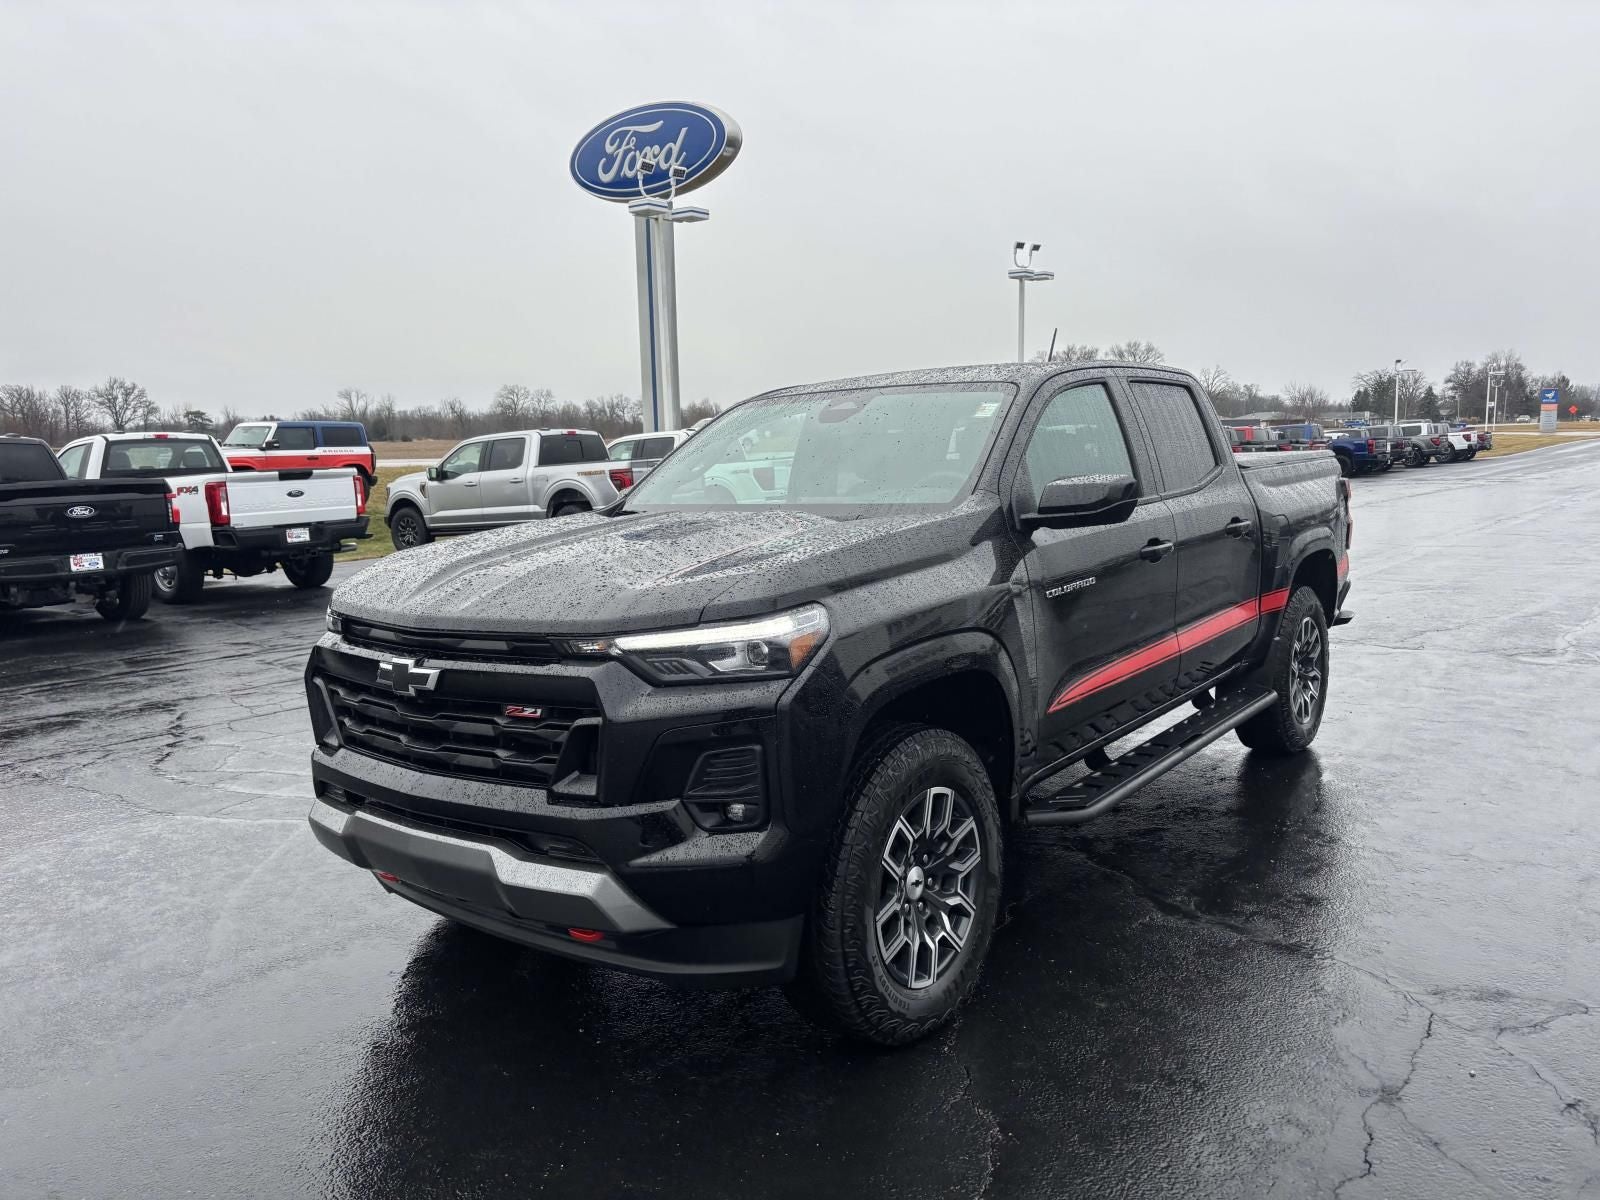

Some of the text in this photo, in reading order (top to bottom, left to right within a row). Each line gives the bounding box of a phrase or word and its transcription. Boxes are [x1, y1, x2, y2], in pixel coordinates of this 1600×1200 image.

[597, 120, 689, 183] Ford
[1045, 576, 1096, 598] COLORADO
[505, 705, 542, 719] Z71
